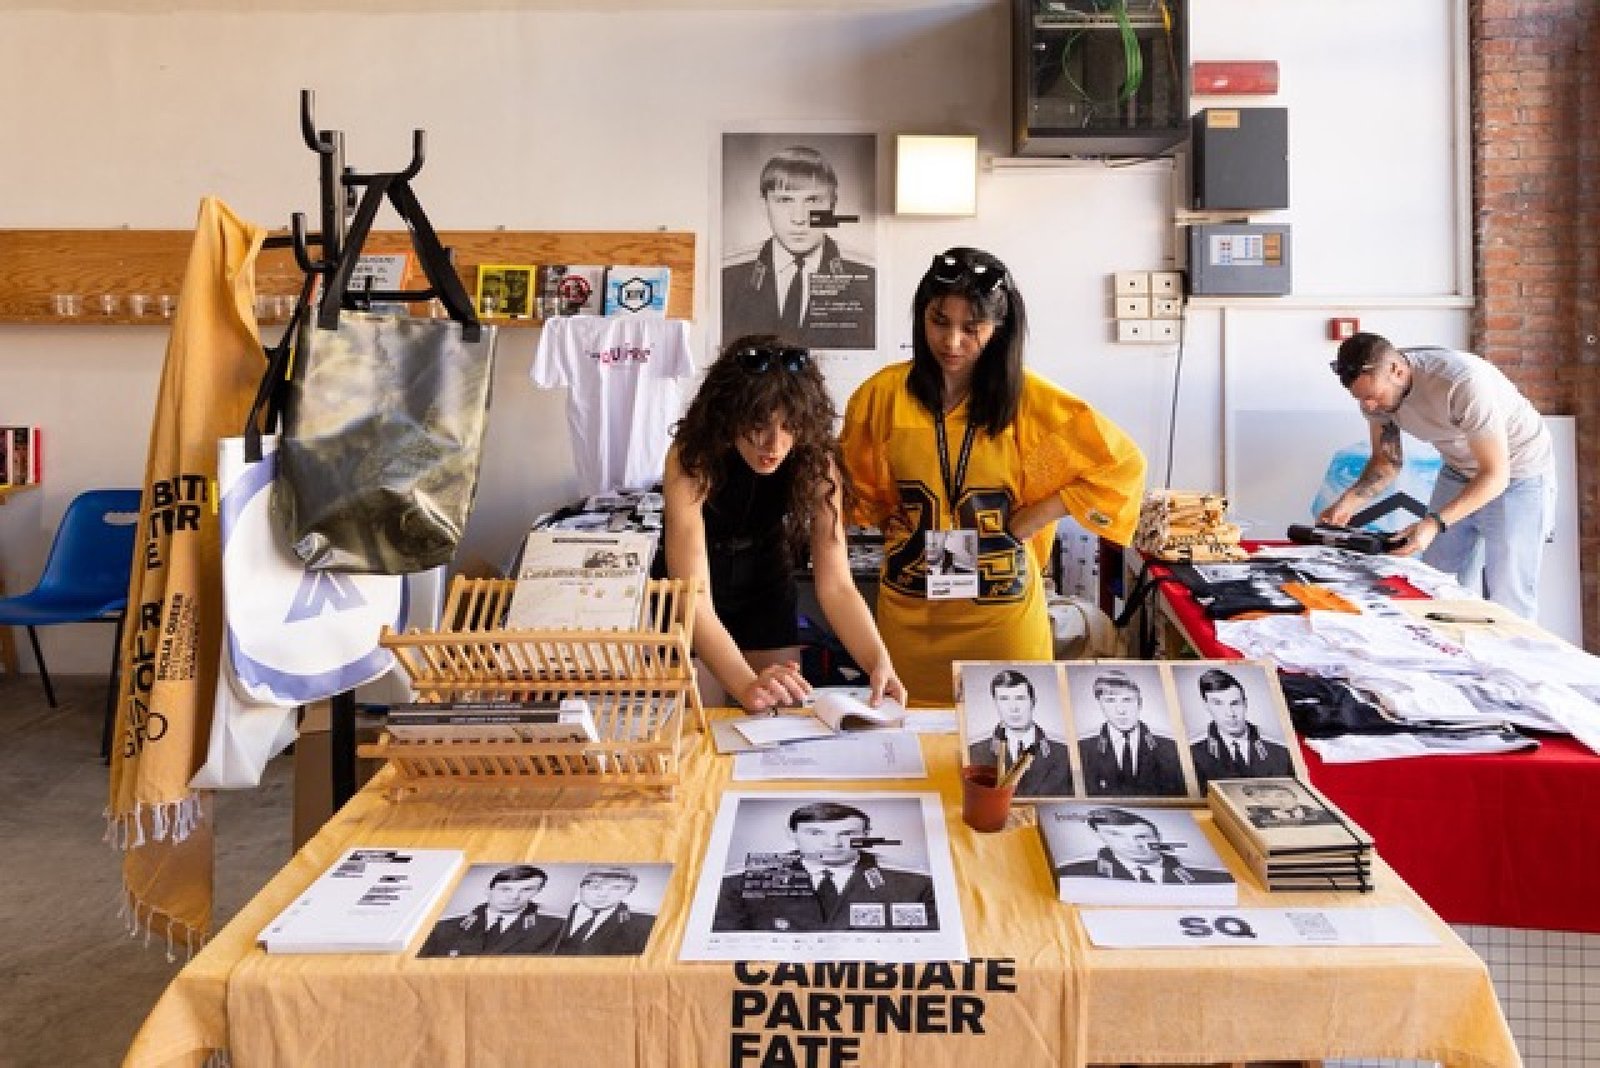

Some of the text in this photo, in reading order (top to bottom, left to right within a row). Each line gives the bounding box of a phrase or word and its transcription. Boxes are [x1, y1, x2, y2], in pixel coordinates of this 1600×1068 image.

[1179, 916, 1257, 938] SQ
[734, 958, 1017, 992] CAMBIATE
[732, 989, 986, 1034] PARTNER
[730, 1033, 861, 1068] FATE
